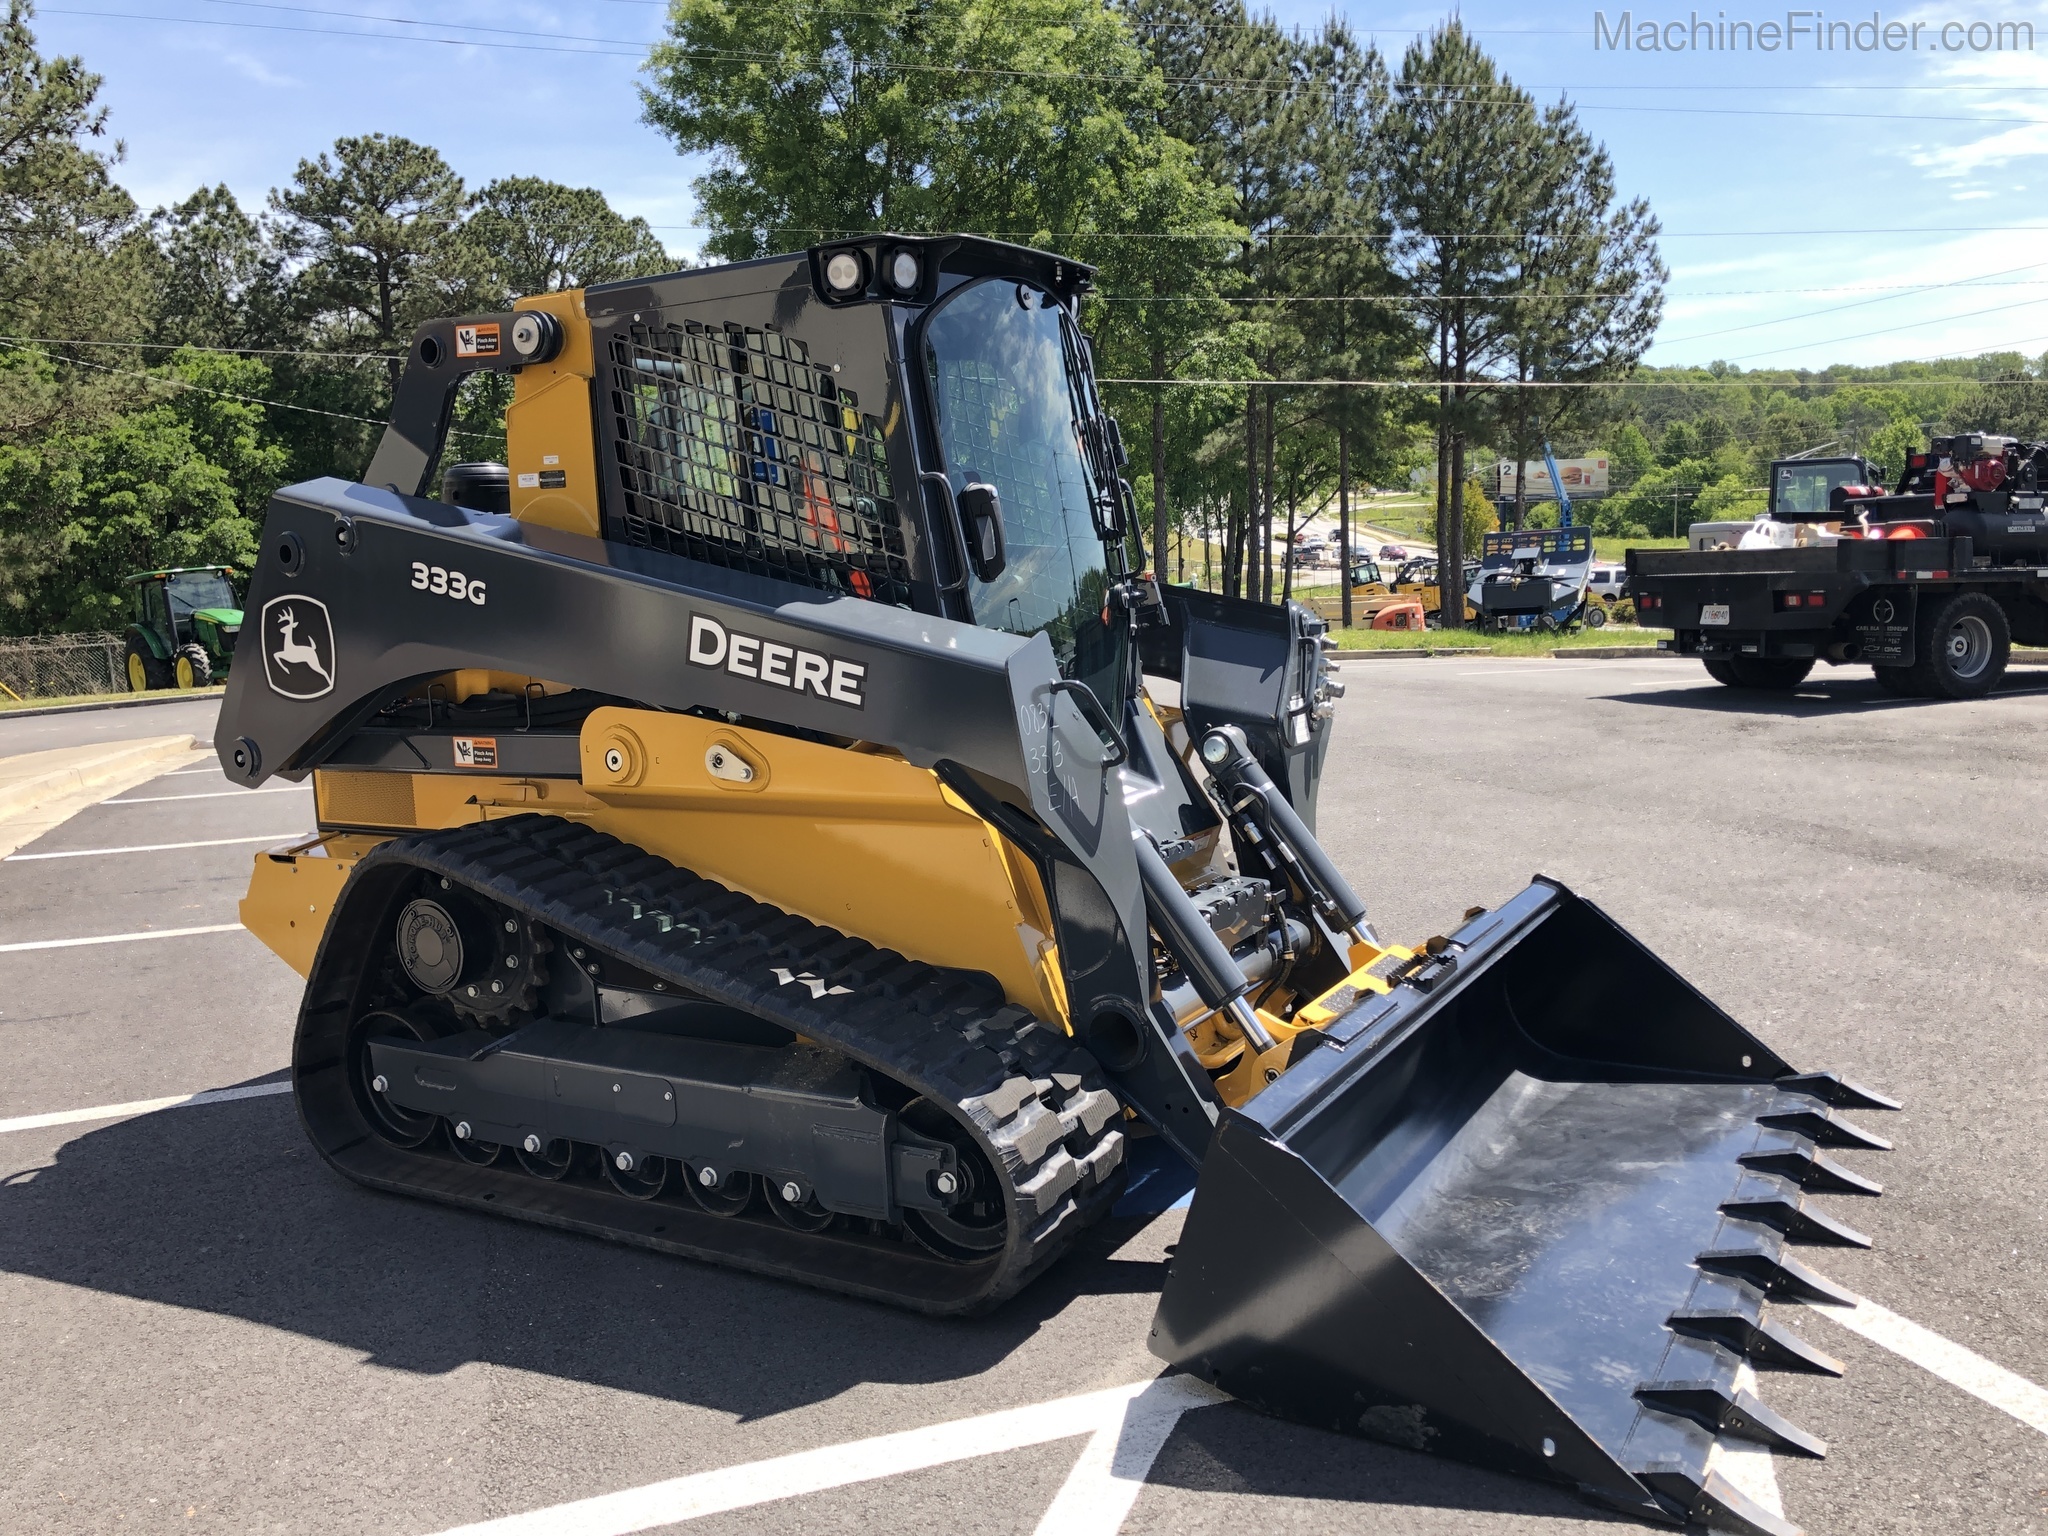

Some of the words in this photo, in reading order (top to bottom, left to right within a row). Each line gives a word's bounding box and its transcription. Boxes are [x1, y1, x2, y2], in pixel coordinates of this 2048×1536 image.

[1503, 465, 1511, 475] 2
[411, 562, 486, 605] 333G
[689, 616, 865, 706] DEERE
[1030, 740, 1064, 774] 333
